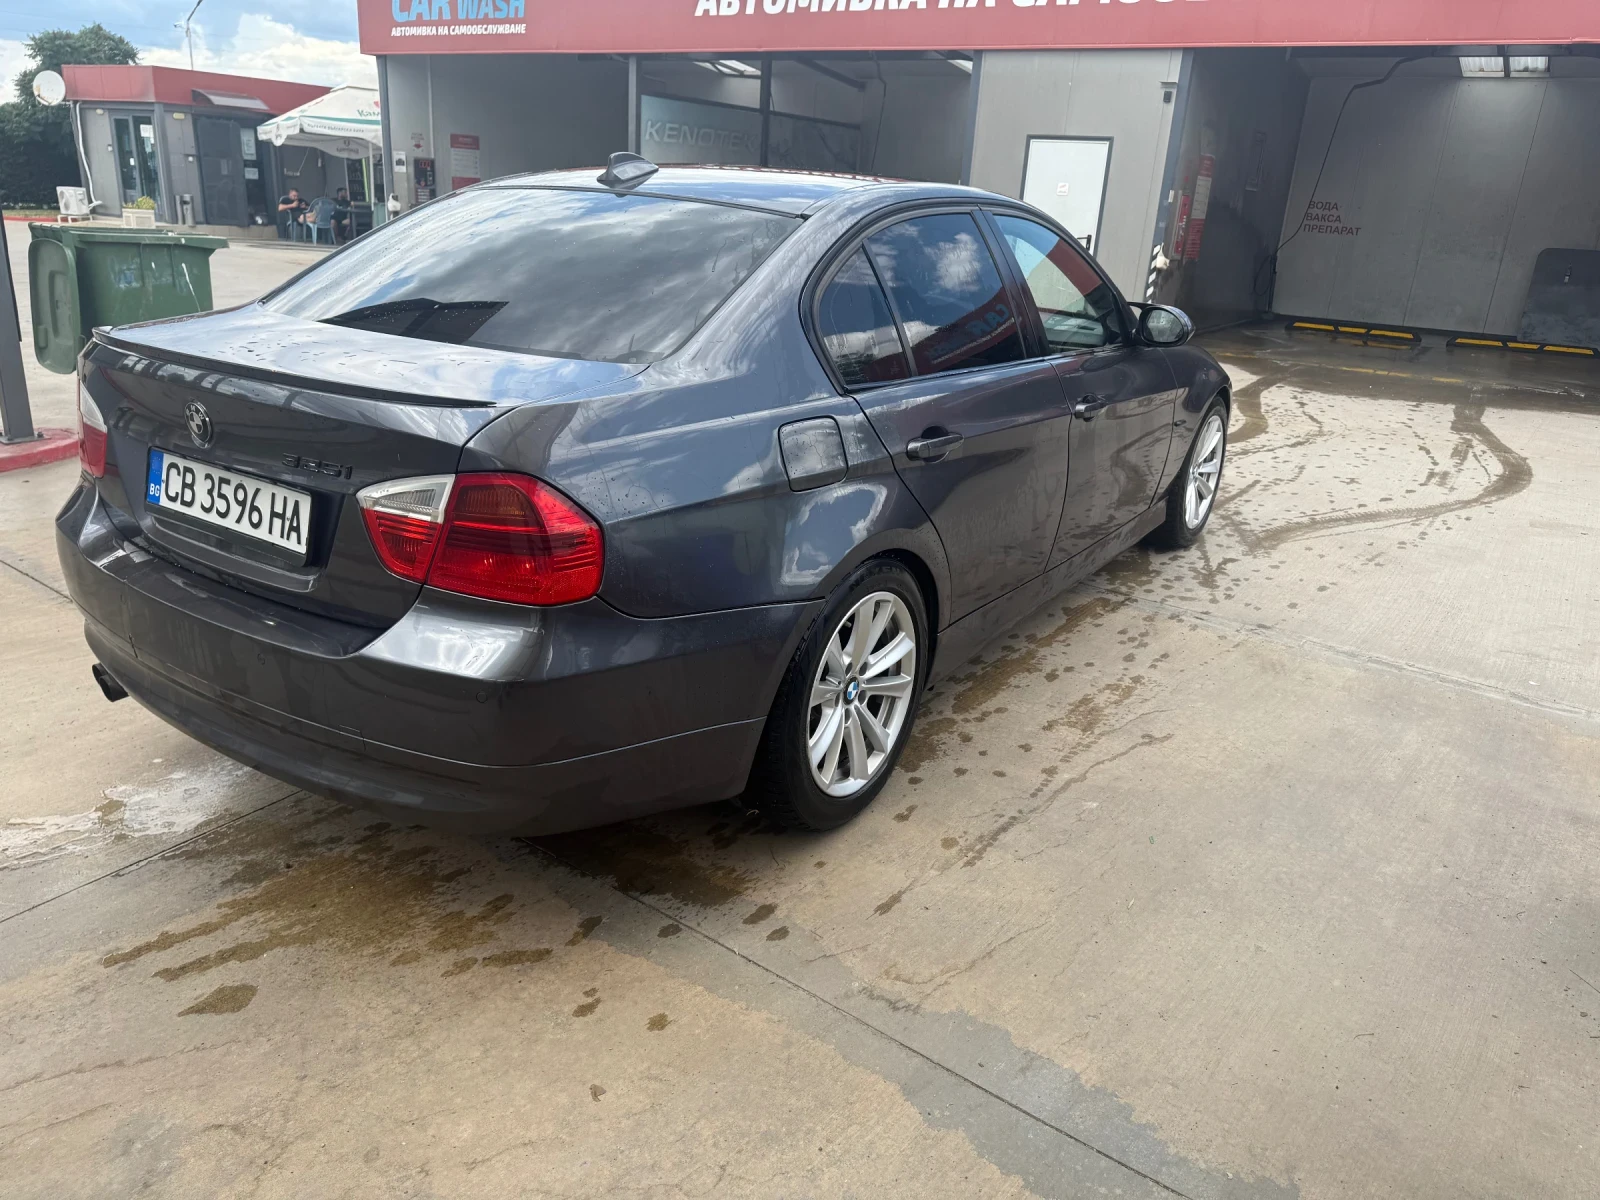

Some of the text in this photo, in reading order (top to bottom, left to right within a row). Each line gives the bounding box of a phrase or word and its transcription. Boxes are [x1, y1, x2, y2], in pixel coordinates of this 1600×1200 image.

[391, 0, 525, 22] CAR WASH
[391, 23, 527, 37] АВТОМИВКА НА САМООБСЛУЖВАНЕ
[645, 120, 759, 153] KENOTEK
[1308, 200, 1339, 212] ВОДА
[1305, 212, 1342, 224] ВАКСА
[1303, 223, 1361, 236] ПРЕПАРАТ
[149, 483, 161, 496] BG
[200, 472, 263, 530] 3596
